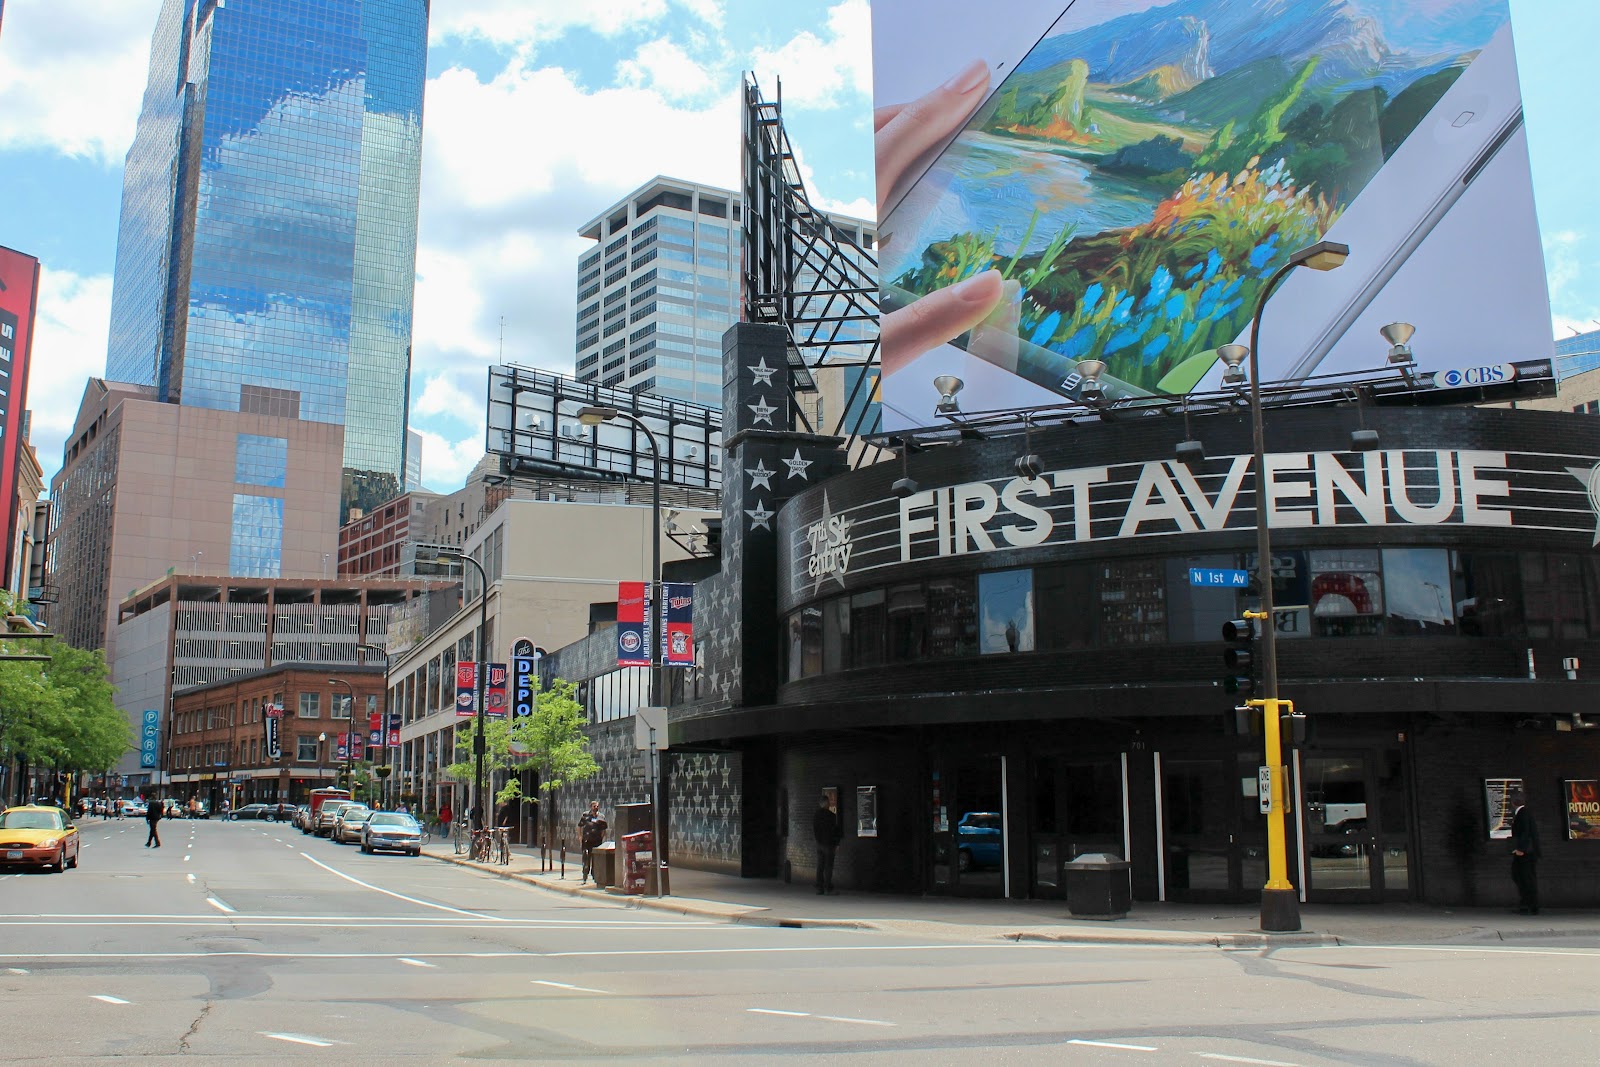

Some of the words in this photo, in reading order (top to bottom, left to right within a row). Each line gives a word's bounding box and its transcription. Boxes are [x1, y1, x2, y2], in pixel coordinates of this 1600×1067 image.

[1465, 365, 1504, 385] CBS
[791, 466, 805, 474] SMOG
[900, 467, 1108, 562] FIRST
[1118, 451, 1513, 537] AVENUE
[807, 521, 828, 555] 7th
[828, 515, 851, 548] St
[809, 543, 853, 577] entry
[1194, 572, 1202, 583] N
[1209, 572, 1224, 583] 1st
[1232, 573, 1245, 584] Av
[517, 643, 530, 656] The
[144, 713, 155, 763] PARK
[1132, 742, 1145, 750] 701
[1261, 770, 1270, 781] ONE
[1261, 783, 1270, 793] WAY
[1568, 802, 1600, 813] RITMO
